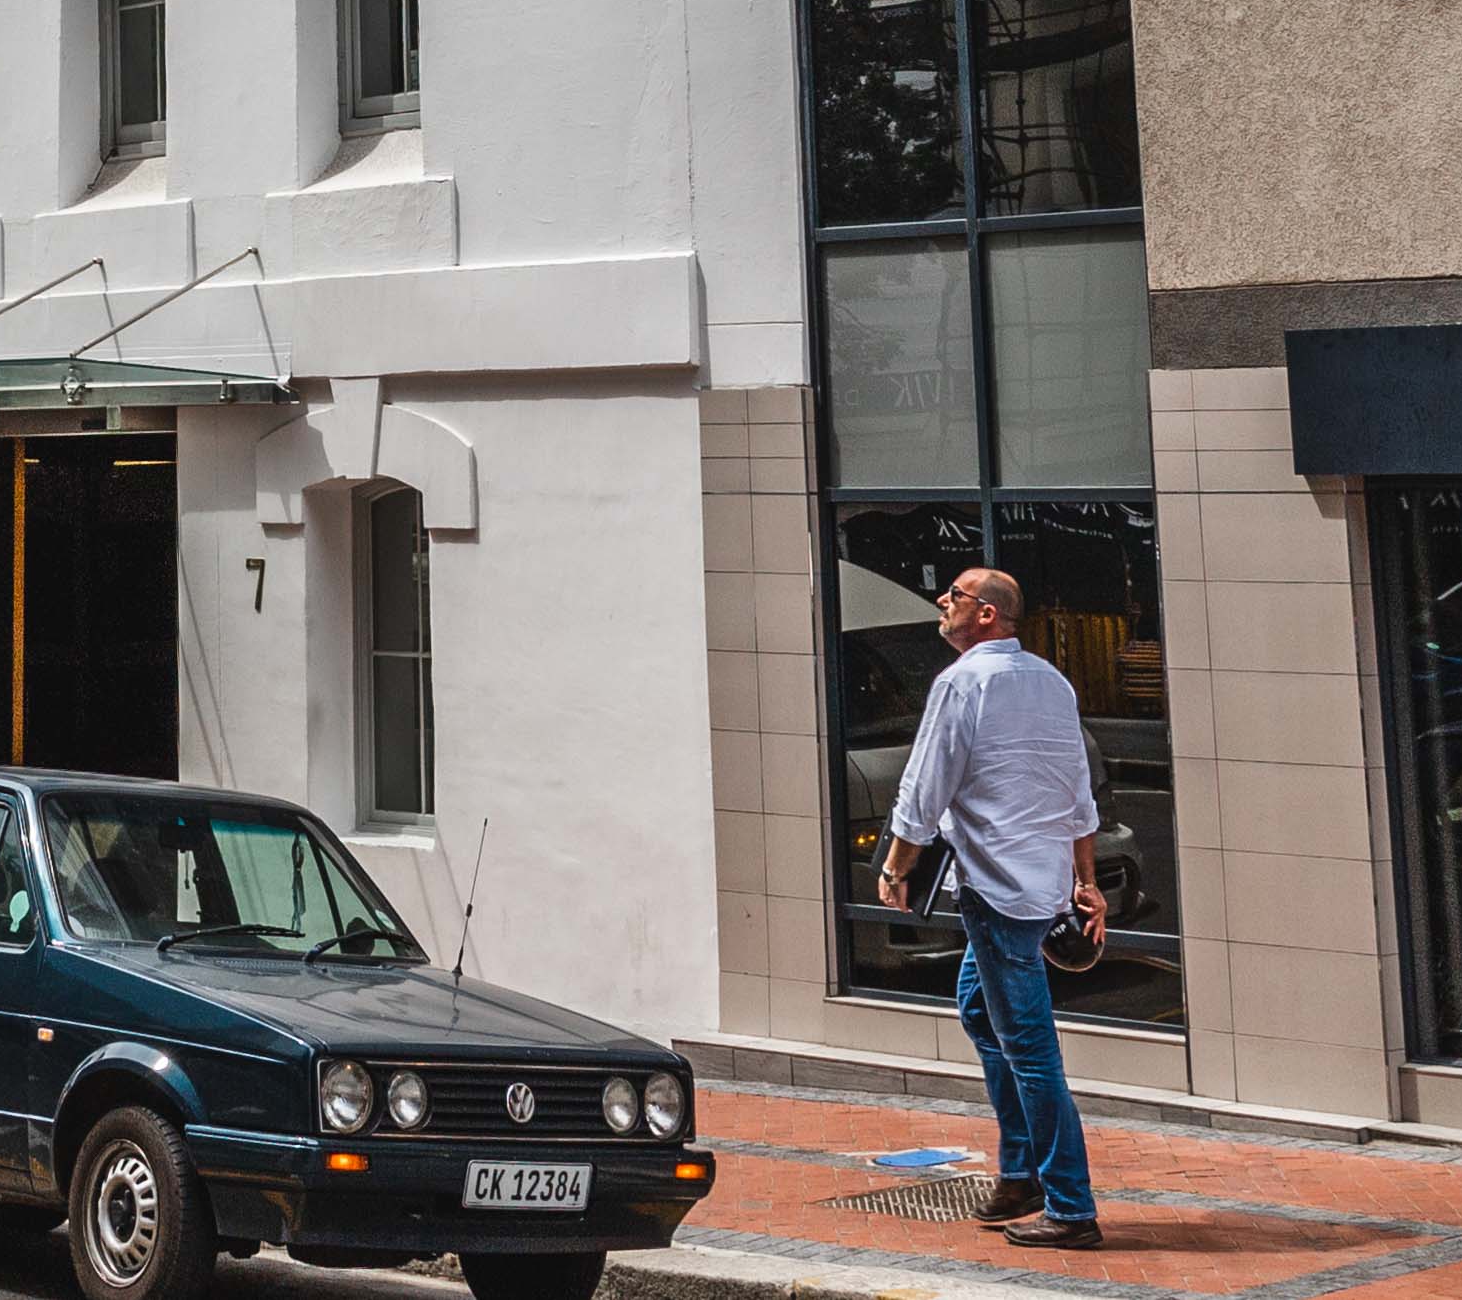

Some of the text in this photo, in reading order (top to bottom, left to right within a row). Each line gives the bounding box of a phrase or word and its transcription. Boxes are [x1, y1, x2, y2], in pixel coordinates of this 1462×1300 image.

[245, 557, 266, 614] 7
[475, 1168, 581, 1202] CK 12384
